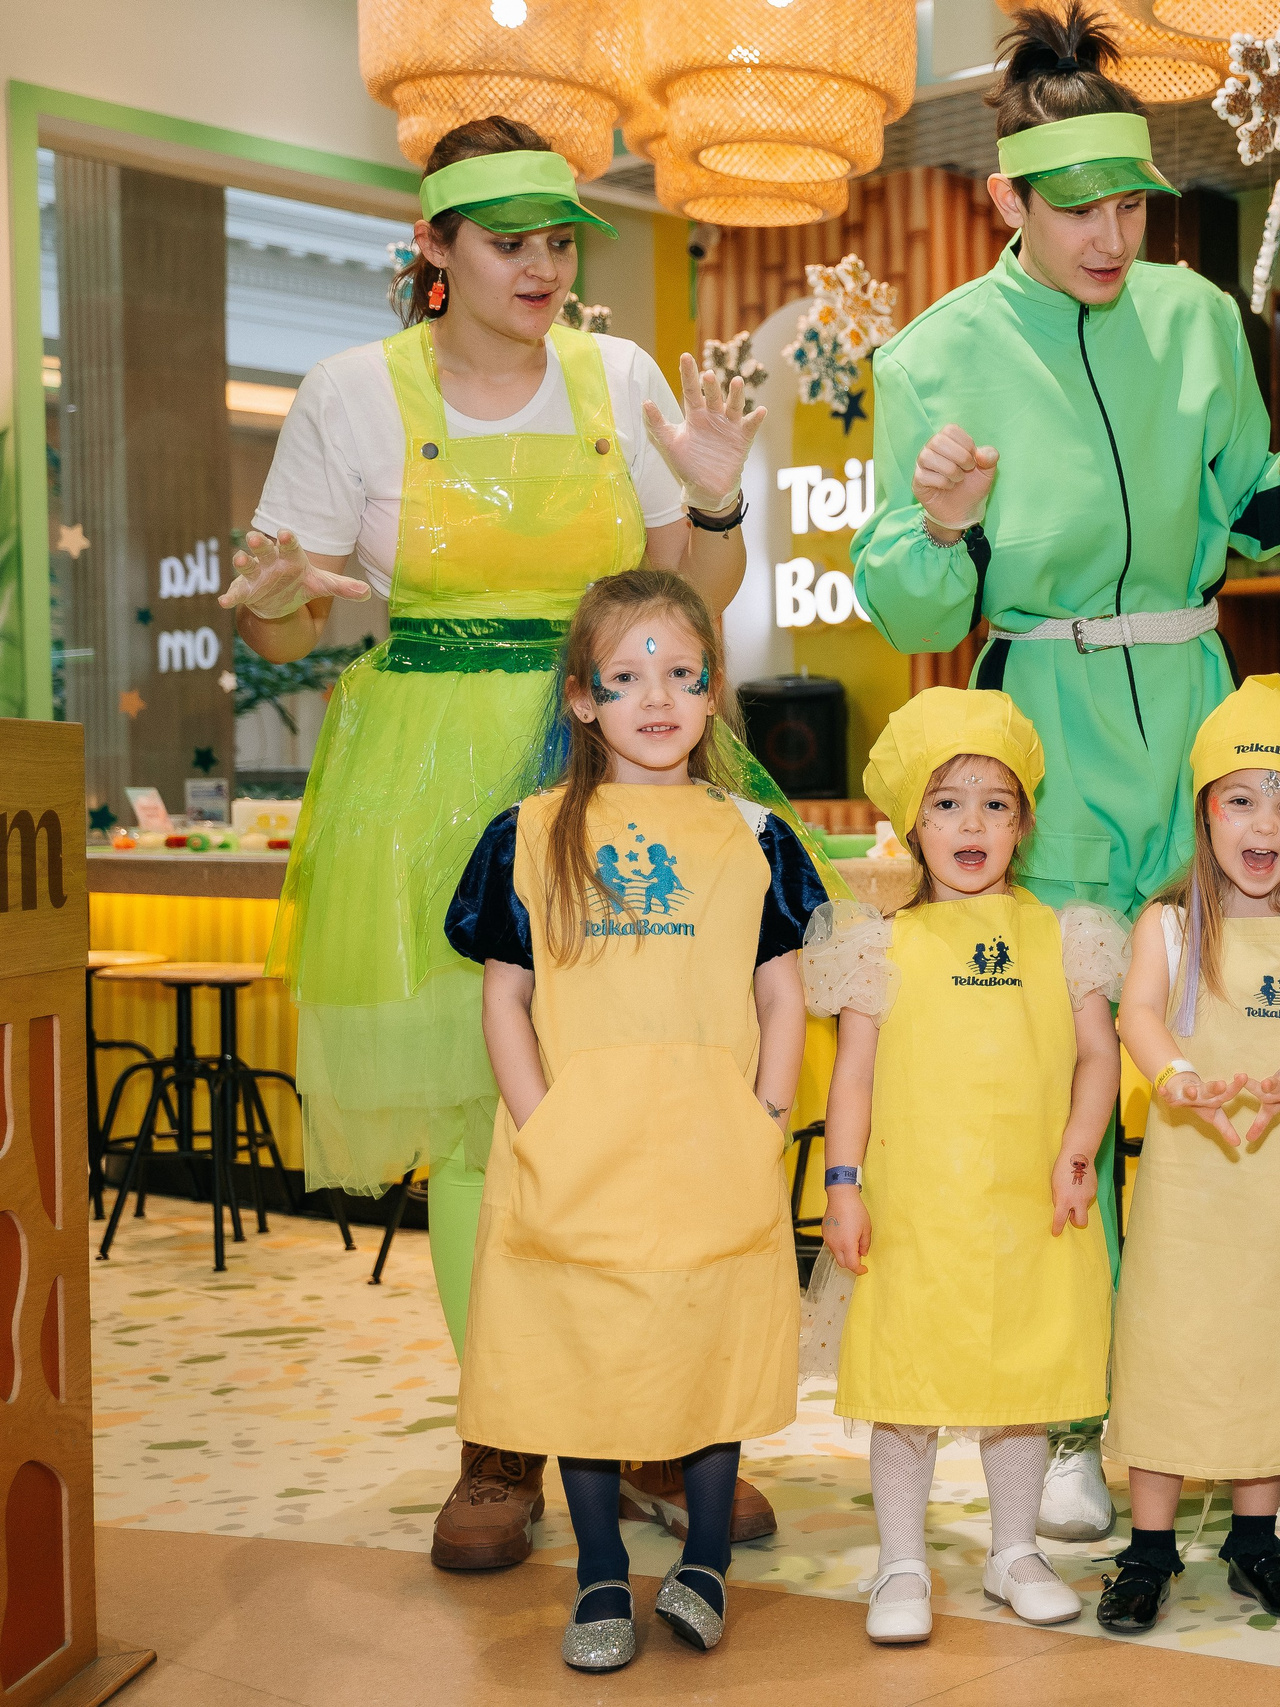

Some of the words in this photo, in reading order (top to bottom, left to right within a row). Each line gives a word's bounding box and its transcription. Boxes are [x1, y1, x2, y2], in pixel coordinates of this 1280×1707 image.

[775, 557, 872, 628] Bo
[580, 918, 695, 937] TeikaBoom
[951, 975, 1023, 987] TeikaBoom
